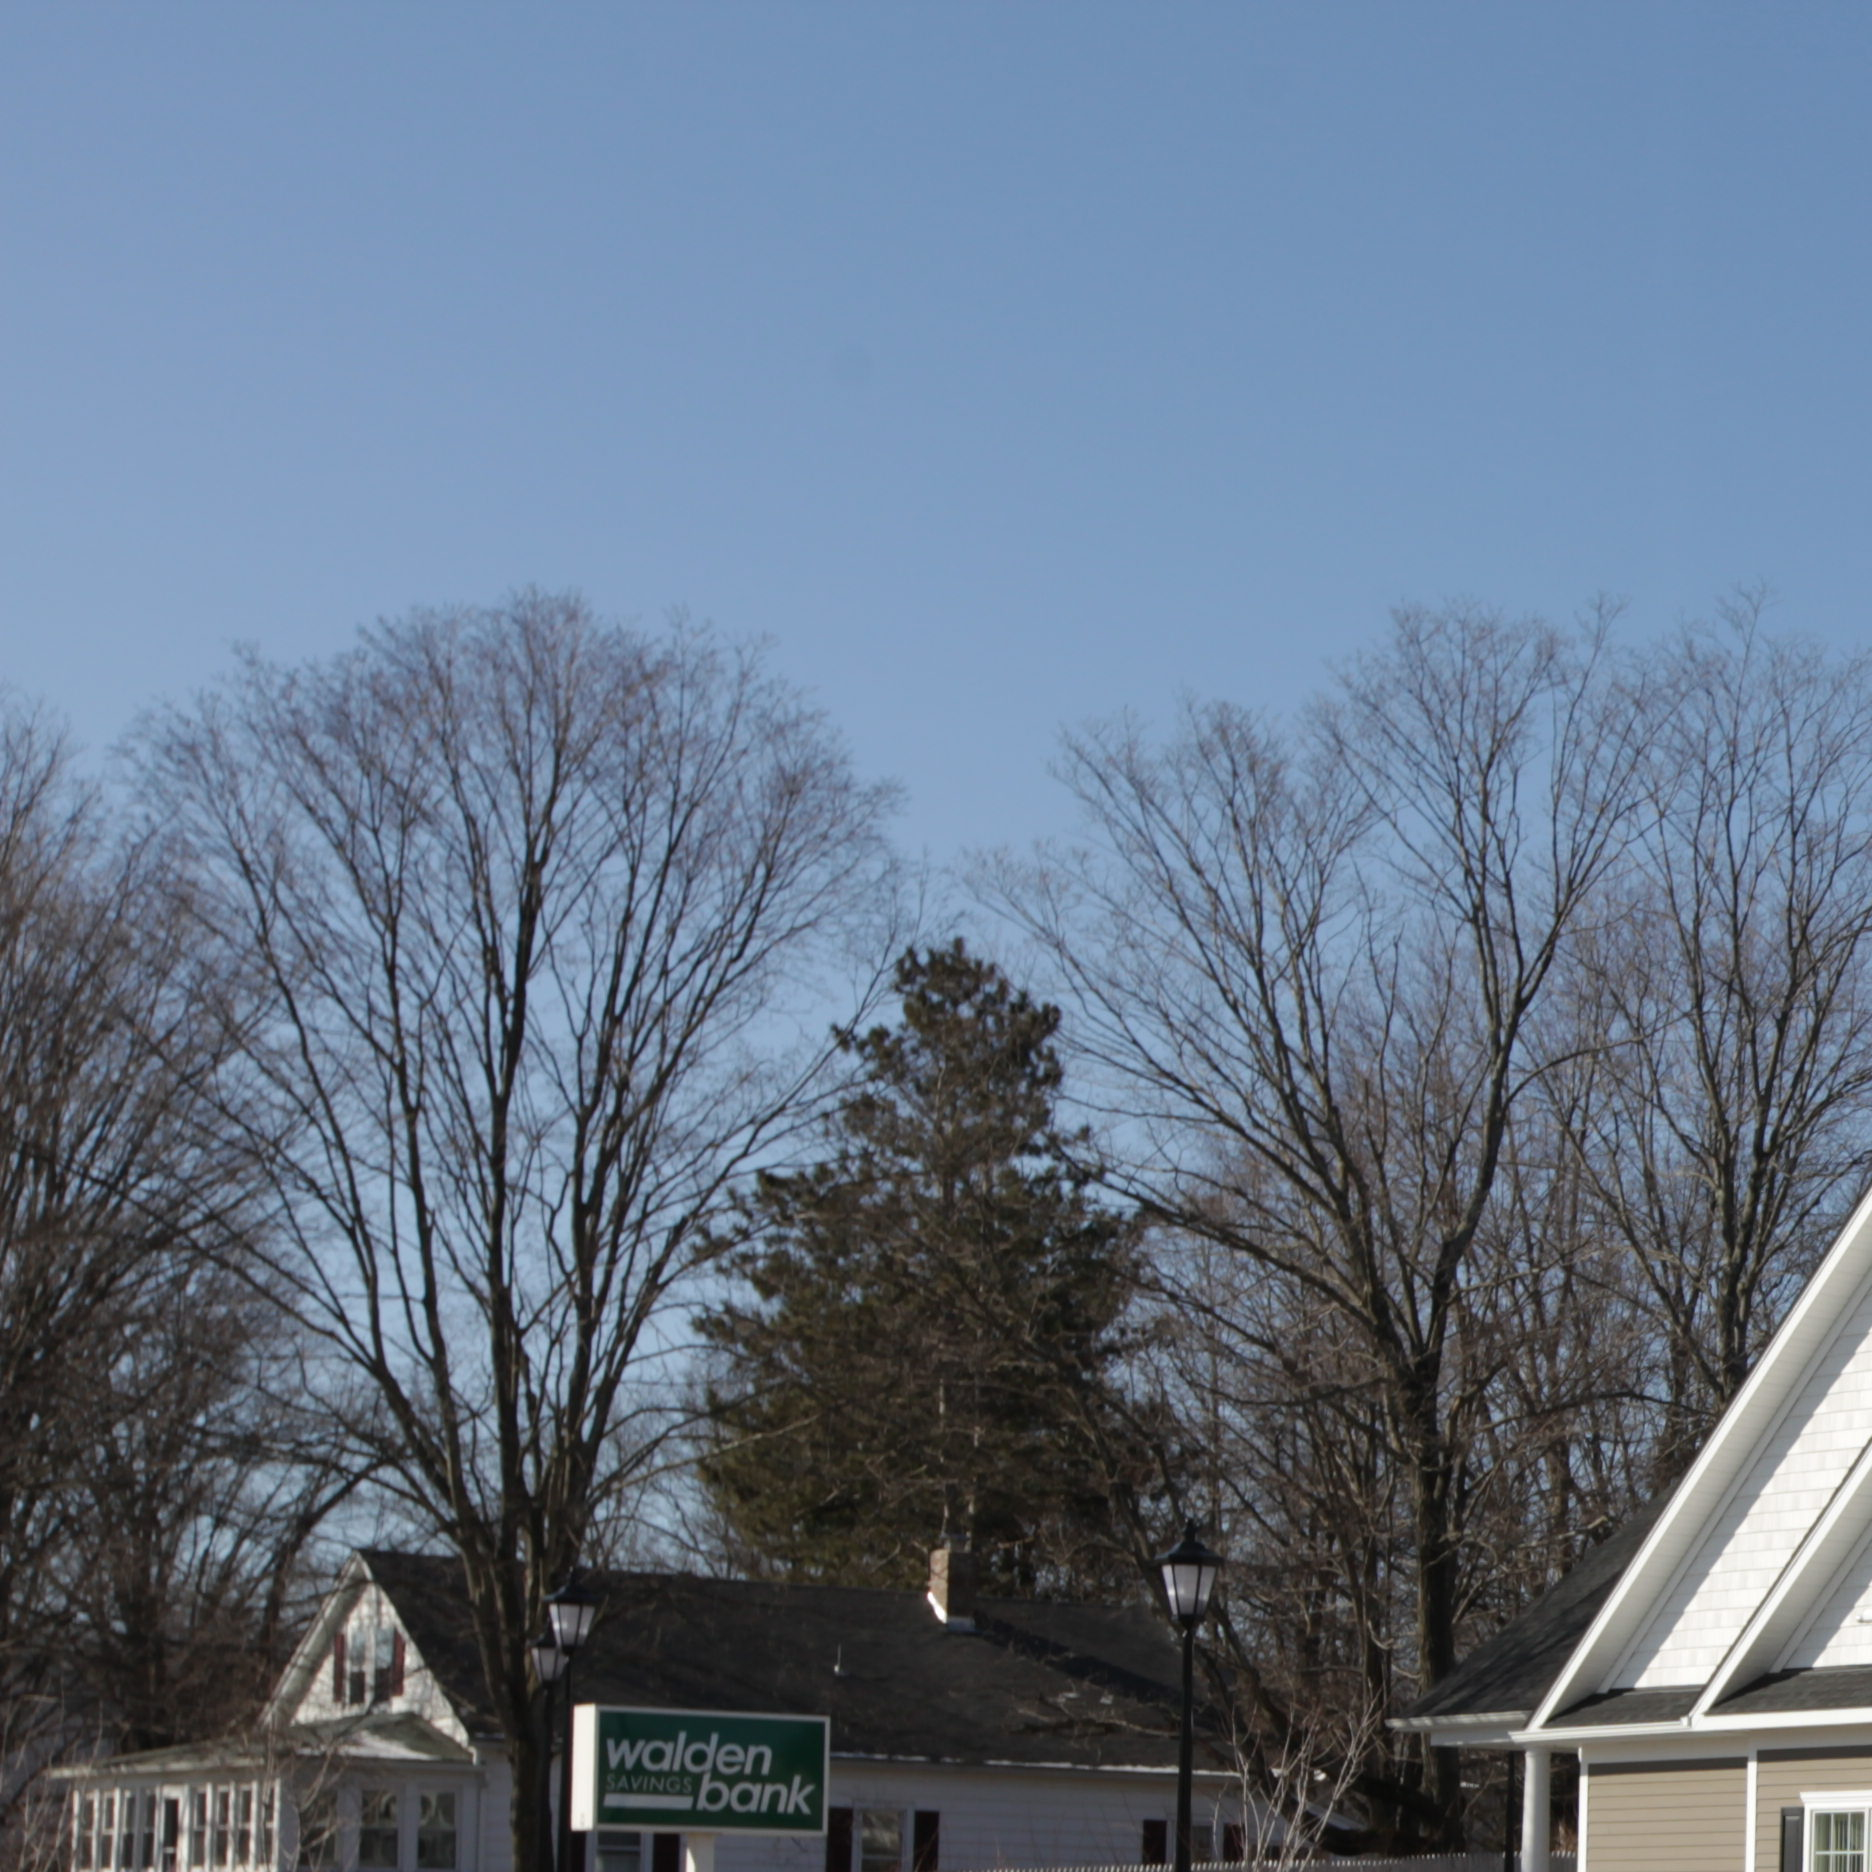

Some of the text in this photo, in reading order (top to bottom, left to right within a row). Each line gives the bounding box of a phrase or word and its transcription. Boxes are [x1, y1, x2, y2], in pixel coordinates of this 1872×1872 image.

[606, 1731, 772, 1776] walden
[606, 1771, 815, 1816] SAVINGS bank
